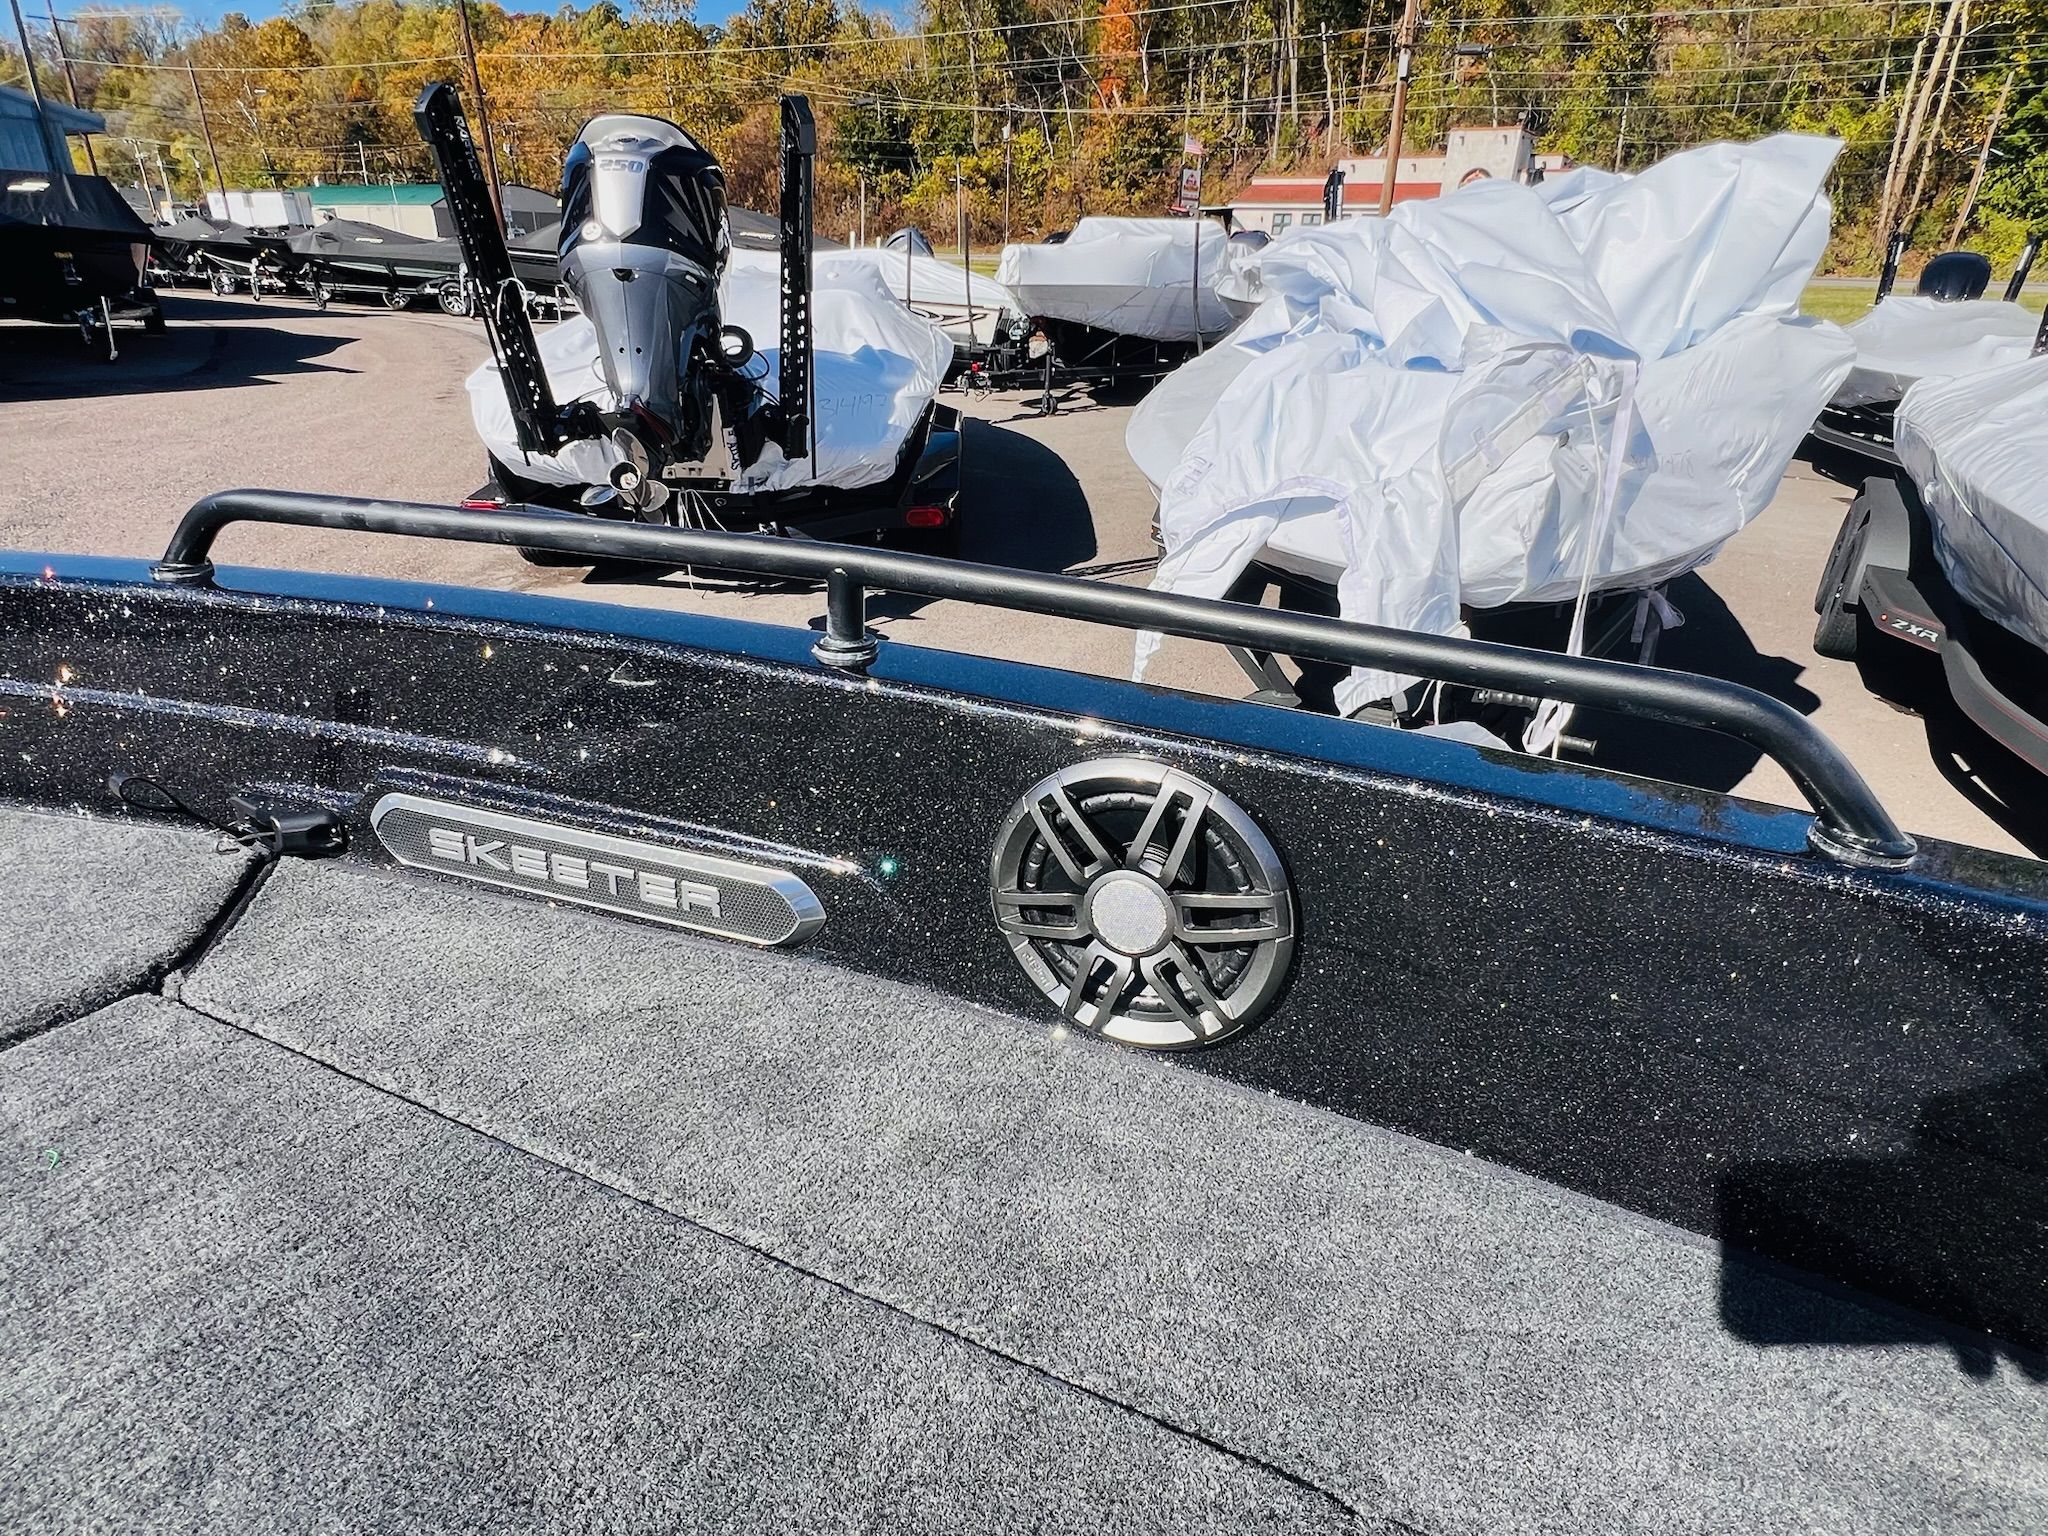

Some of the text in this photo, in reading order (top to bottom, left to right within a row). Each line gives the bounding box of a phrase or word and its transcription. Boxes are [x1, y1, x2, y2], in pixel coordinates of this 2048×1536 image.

[599, 158, 644, 173] 250
[1891, 618, 1939, 643] ZXR
[428, 827, 721, 918] SKEETER
